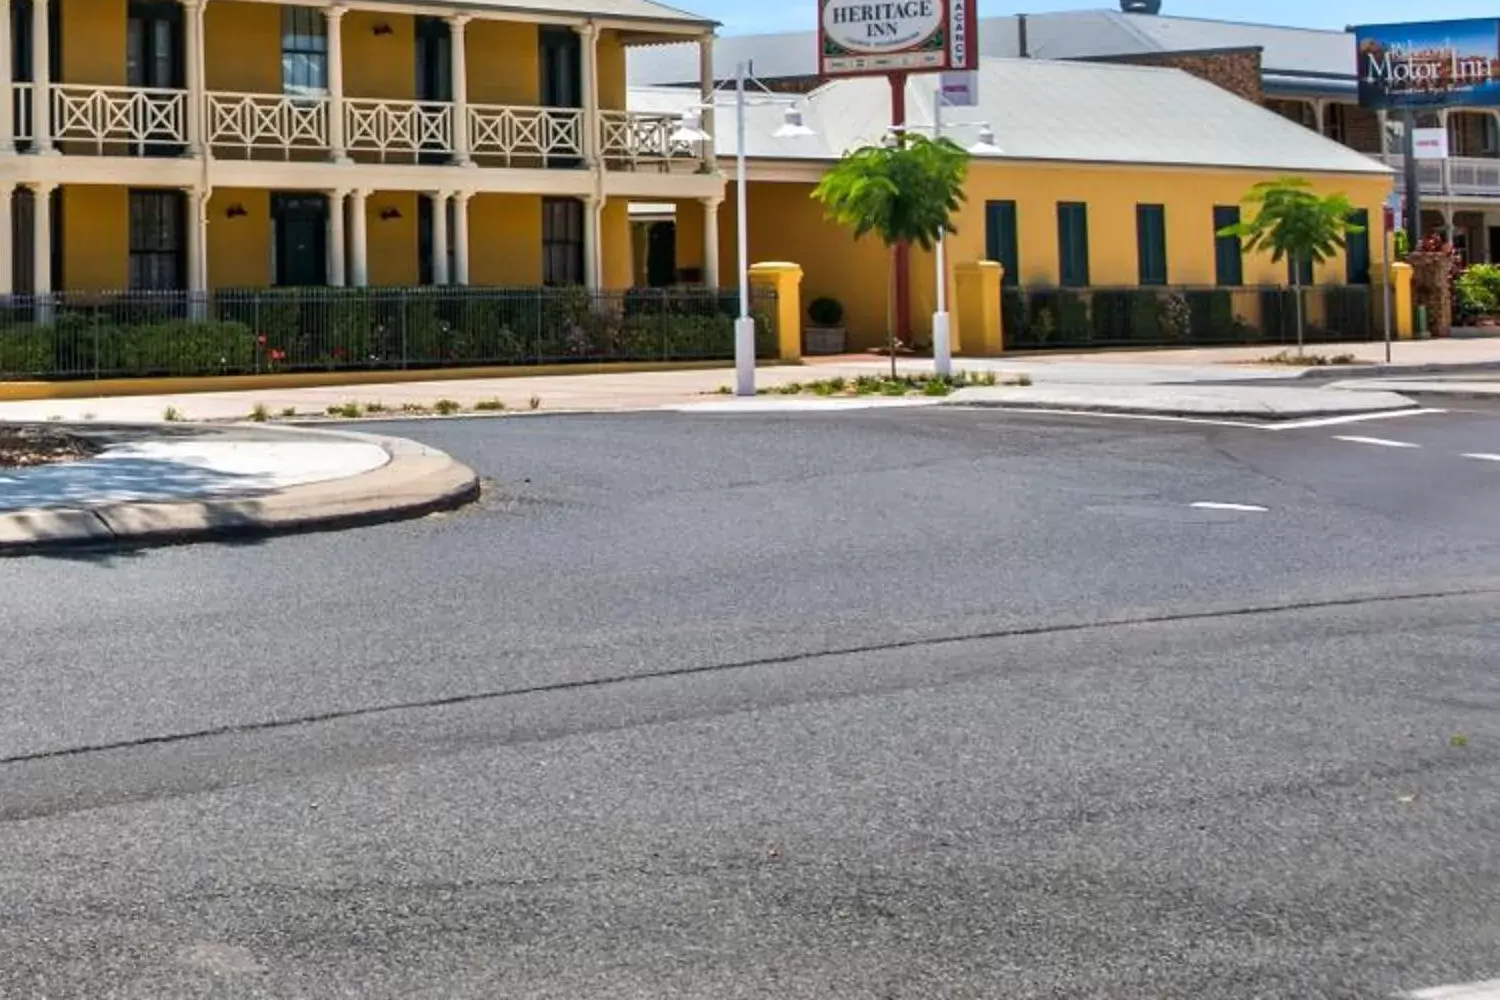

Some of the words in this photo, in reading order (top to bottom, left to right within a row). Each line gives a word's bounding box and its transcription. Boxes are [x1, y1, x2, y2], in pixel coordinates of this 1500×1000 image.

[833, 0, 933, 25] HERITAGE
[866, 22, 898, 37] INN
[1367, 52, 1442, 83] Motor
[1451, 48, 1492, 81] Inn
